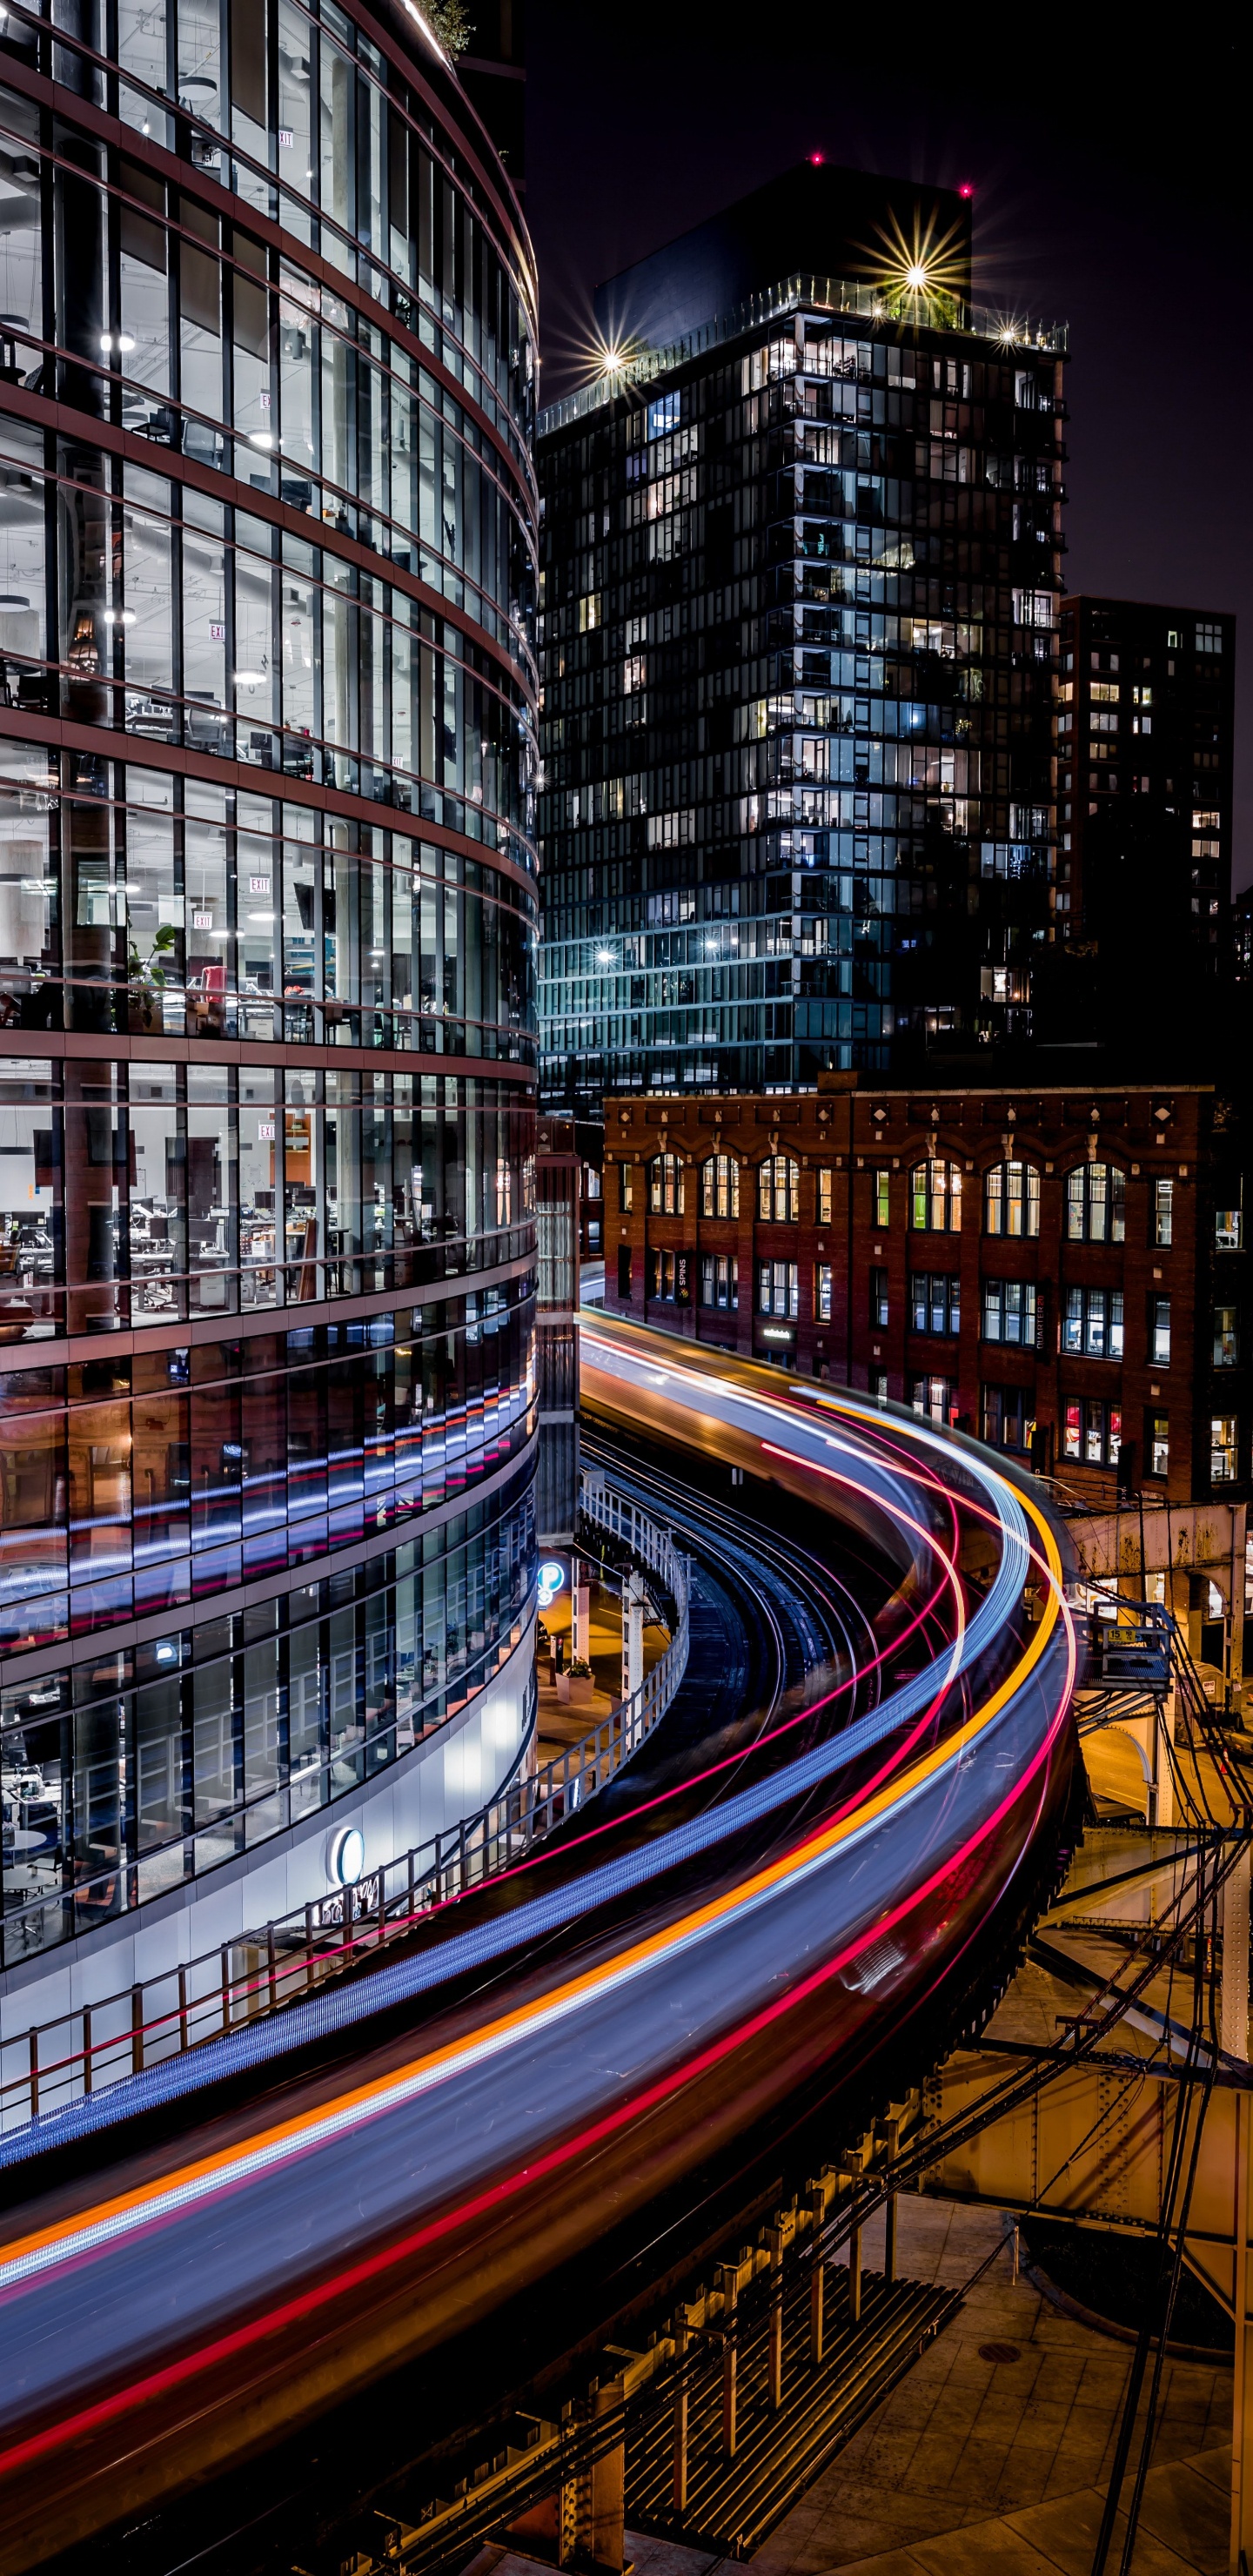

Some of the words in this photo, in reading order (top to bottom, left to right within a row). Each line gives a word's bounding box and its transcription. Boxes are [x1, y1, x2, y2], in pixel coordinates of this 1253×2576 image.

[211, 625, 225, 638] EXI
[251, 878, 268, 891] EXIT
[196, 916, 211, 927] EXIT
[542, 1566, 559, 1588] P
[1110, 1630, 1121, 1639] 15
